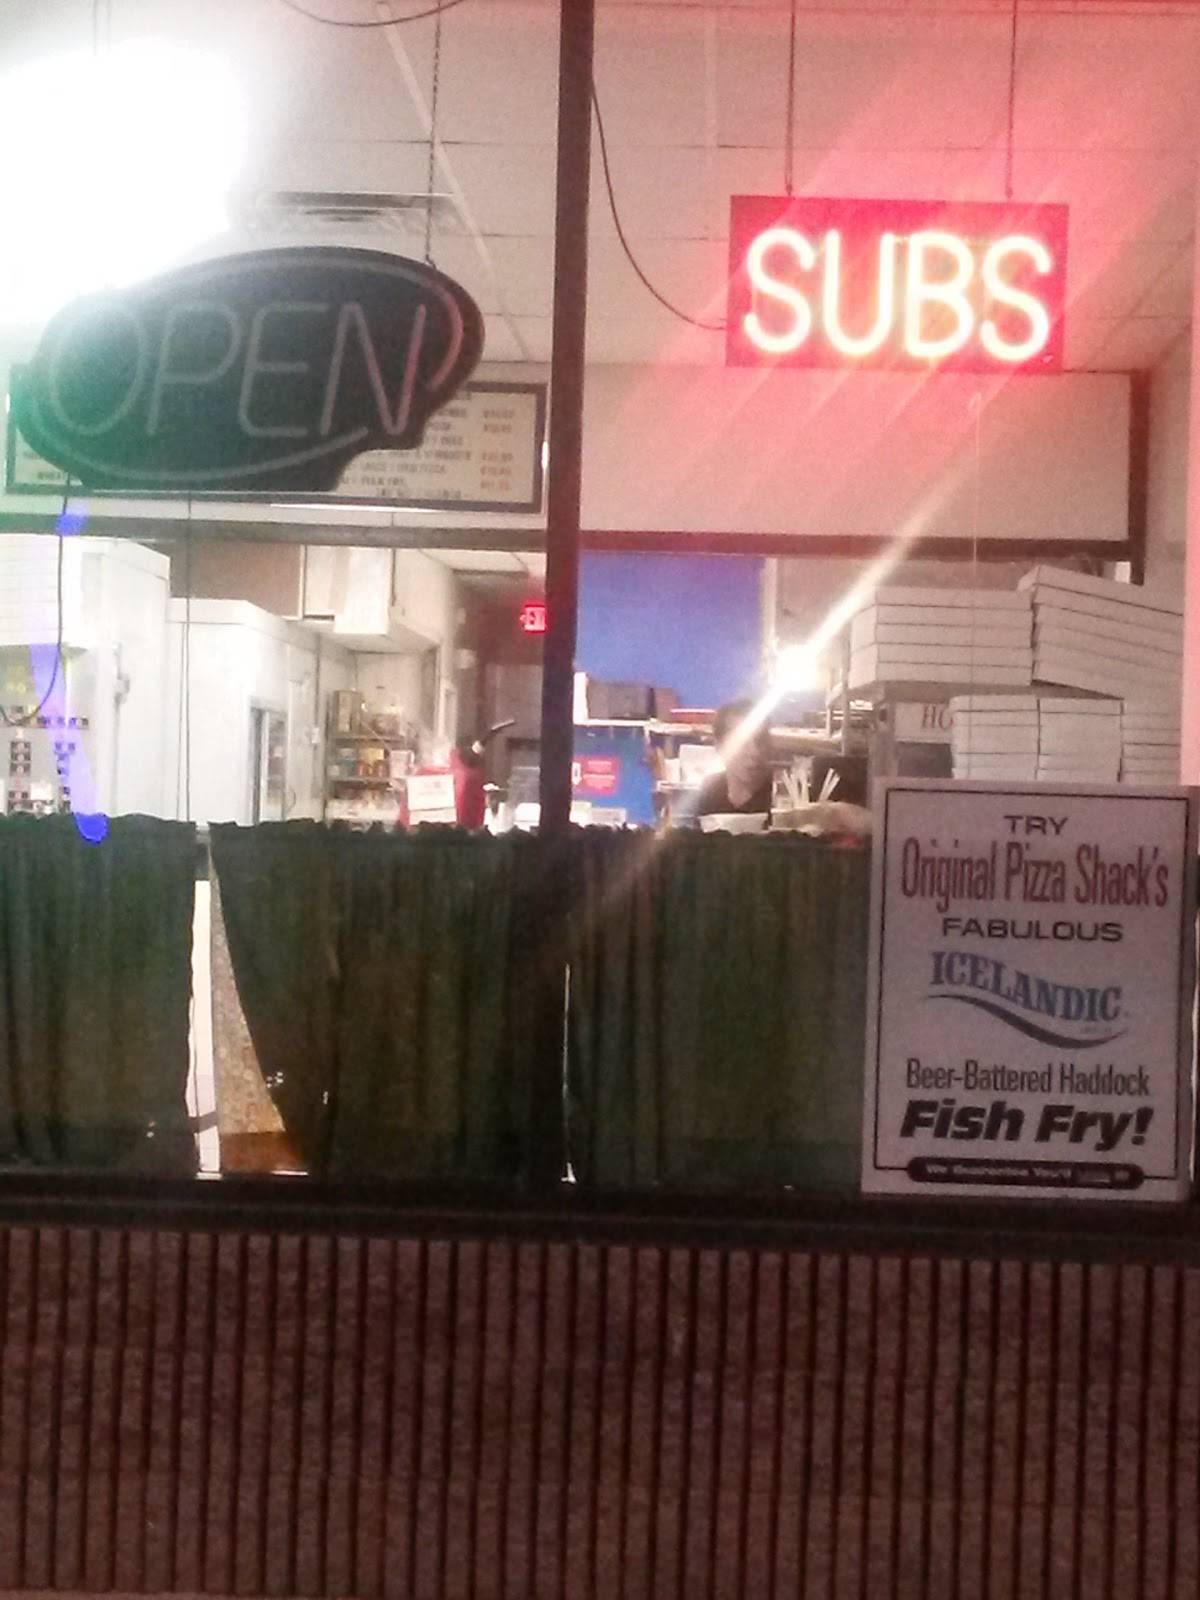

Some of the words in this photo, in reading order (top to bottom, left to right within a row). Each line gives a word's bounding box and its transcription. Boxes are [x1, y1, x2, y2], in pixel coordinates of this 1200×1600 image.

[743, 226, 1053, 363] SUBS
[50, 300, 428, 437] OPEN
[1004, 815, 1069, 835] TRY
[901, 837, 996, 913] Original
[1003, 841, 1066, 903] Pizza
[1074, 843, 1169, 908] Shack's
[942, 917, 1123, 942] FABULOUS
[929, 951, 1123, 1022] ICELANDIC
[906, 1058, 1051, 1094] Beer-Battered
[1059, 1063, 1151, 1096] Haddock
[899, 1098, 1026, 1142] Fish
[1034, 1104, 1155, 1152] Fry!
